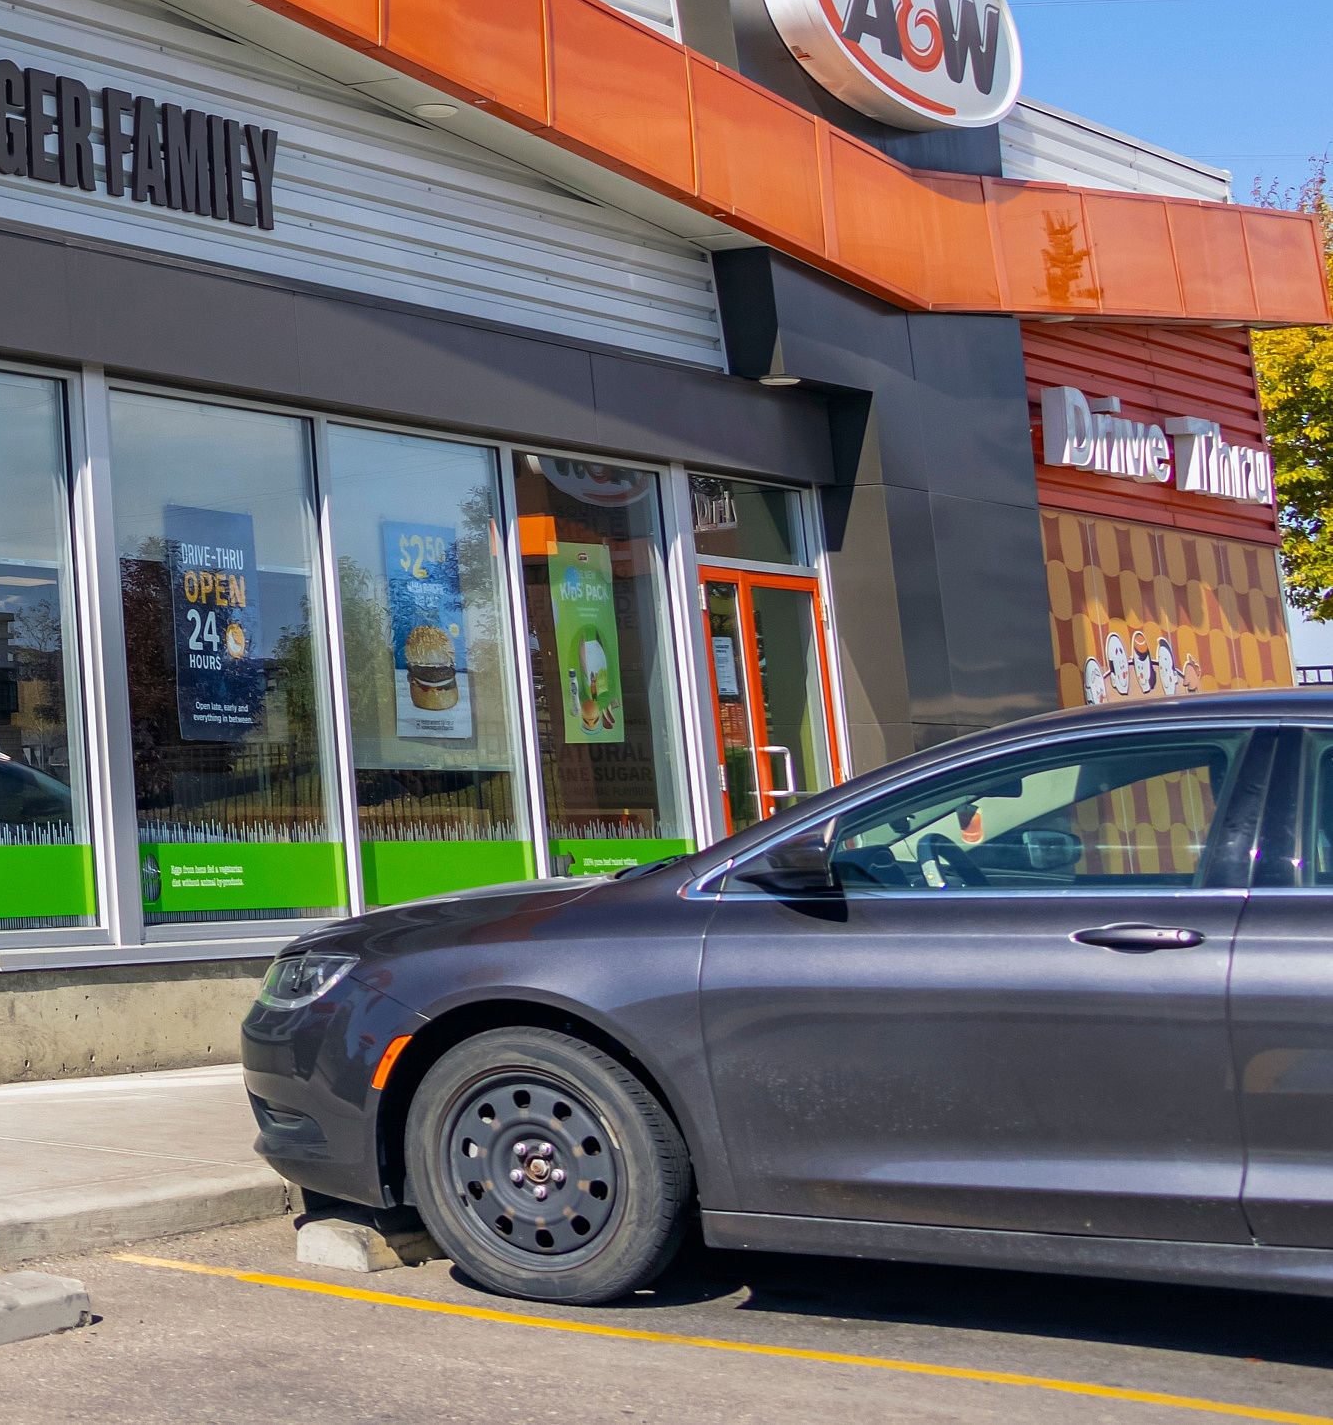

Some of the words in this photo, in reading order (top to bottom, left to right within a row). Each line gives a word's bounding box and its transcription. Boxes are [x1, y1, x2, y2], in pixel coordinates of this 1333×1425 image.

[102, 87, 278, 231] FAMILY
[1041, 386, 1172, 484] Drive
[1165, 415, 1273, 505] Thru
[181, 542, 244, 571] DRIVE-THRU
[184, 570, 246, 608] OPEN
[585, 583, 610, 602] PACK
[187, 609, 220, 651] 24
[189, 654, 222, 671] HOURS
[195, 701, 210, 710] Open
[211, 702, 223, 712] late,
[224, 703, 237, 713] early
[238, 704, 249, 712] and
[193, 714, 222, 723] everything
[222, 714, 228, 722] in
[170, 865, 182, 876] Eggs
[182, 864, 195, 874] from
[219, 865, 244, 875] vegetarian
[182, 878, 200, 887] without
[200, 878, 216, 887] animal
